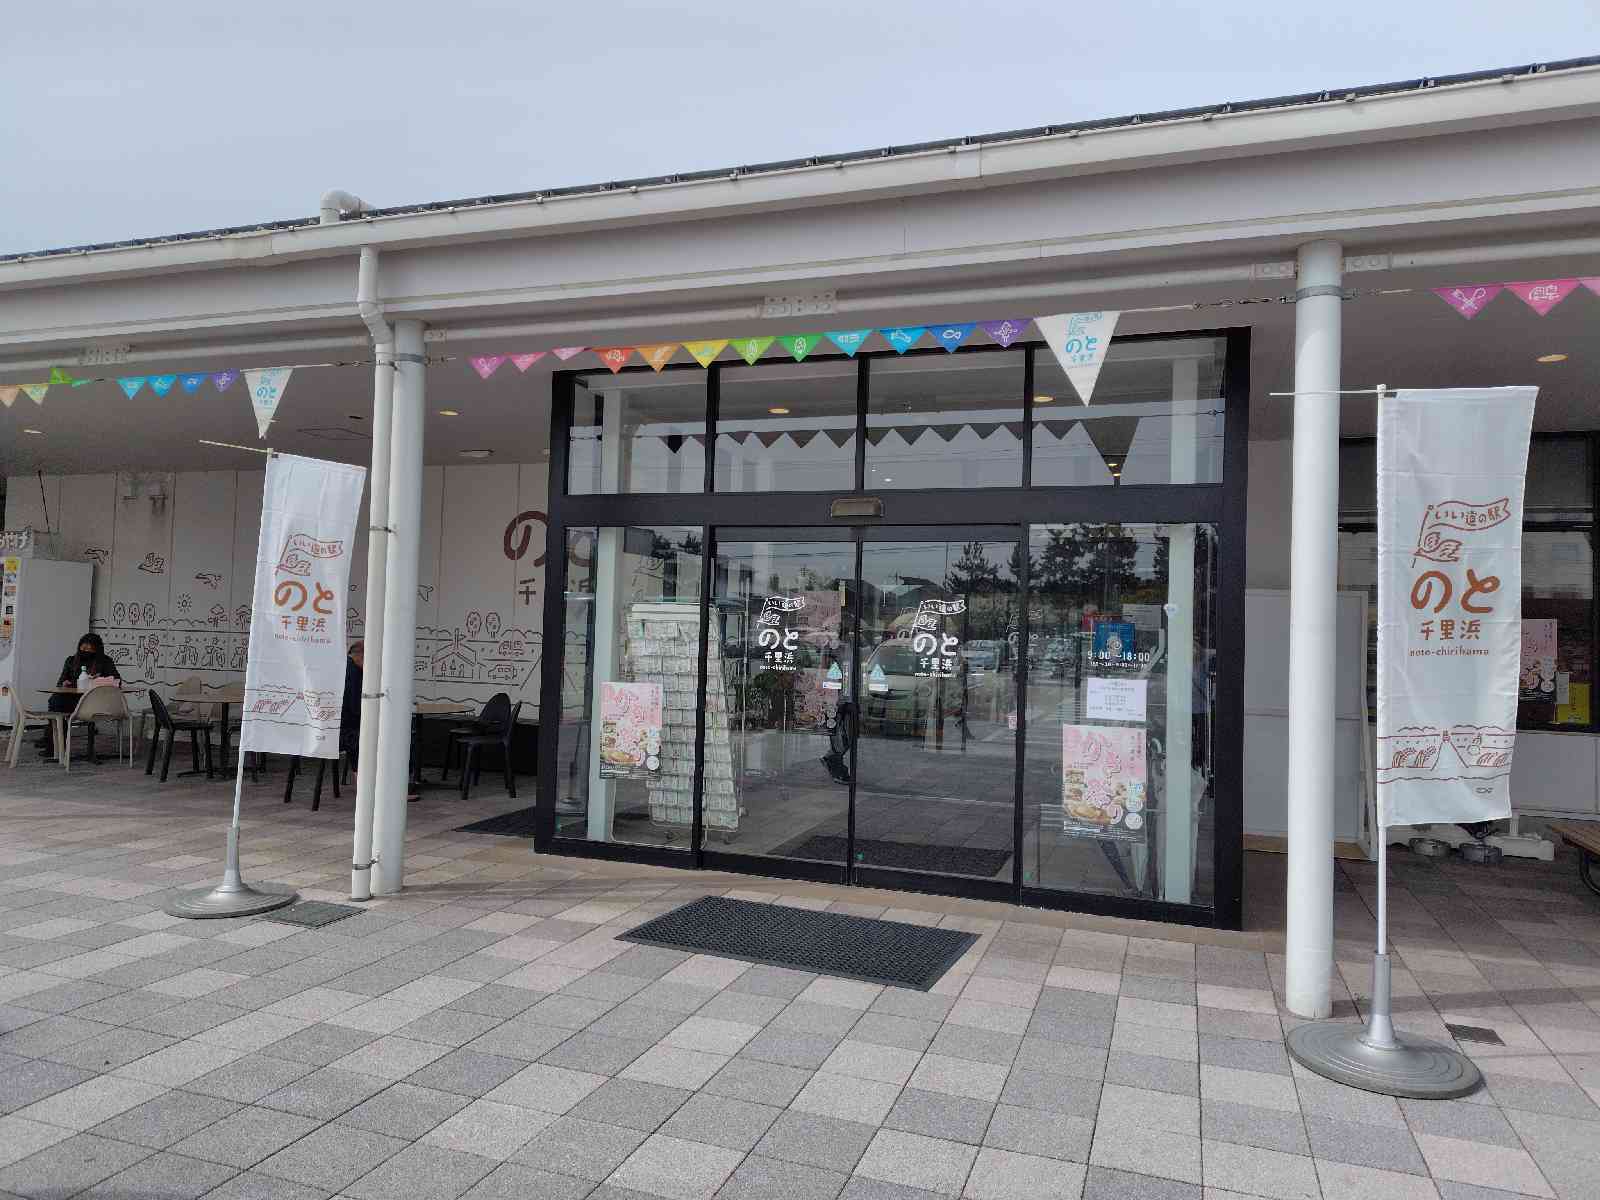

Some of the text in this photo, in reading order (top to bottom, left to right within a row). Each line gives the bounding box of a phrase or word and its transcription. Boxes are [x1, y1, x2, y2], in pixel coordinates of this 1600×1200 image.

[1066, 336, 1098, 353] のと
[1435, 507, 1501, 526] いい道の駅
[274, 581, 335, 614] のと
[1410, 568, 1501, 614] のと
[281, 615, 326, 633] 千里浜
[1420, 619, 1481, 641] 千里浜
[758, 628, 799, 651] のと
[913, 632, 959, 656] のと
[765, 651, 795, 664] 千里浜
[1409, 645, 1489, 657] noto-chirihama
[920, 657, 953, 671] 千里浜
